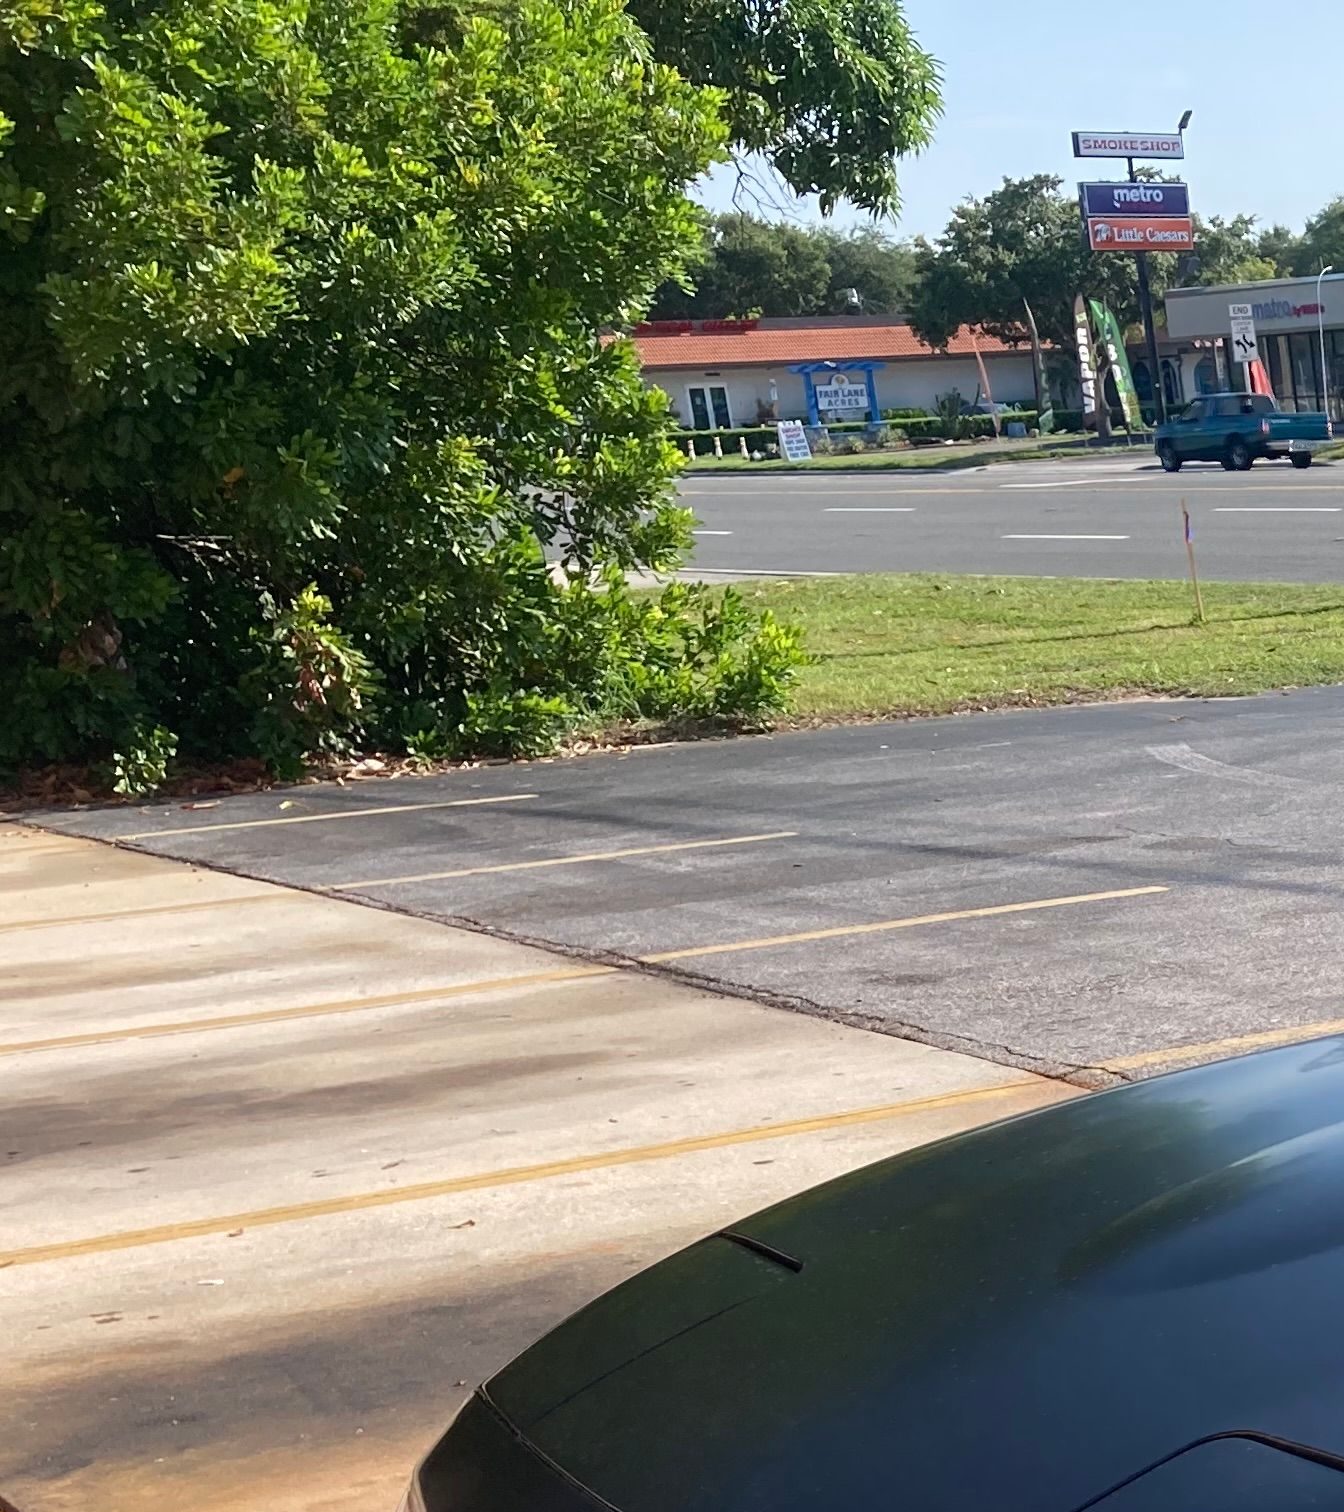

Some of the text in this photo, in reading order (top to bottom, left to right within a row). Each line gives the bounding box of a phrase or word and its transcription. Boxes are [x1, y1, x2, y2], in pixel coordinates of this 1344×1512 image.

[1113, 184, 1164, 203] metro
[1112, 227, 1189, 242] Little Caesars
[1232, 306, 1249, 315] END
[1252, 299, 1291, 319] metro
[819, 388, 865, 398] FAIR LANE
[827, 398, 860, 406] ACRES
